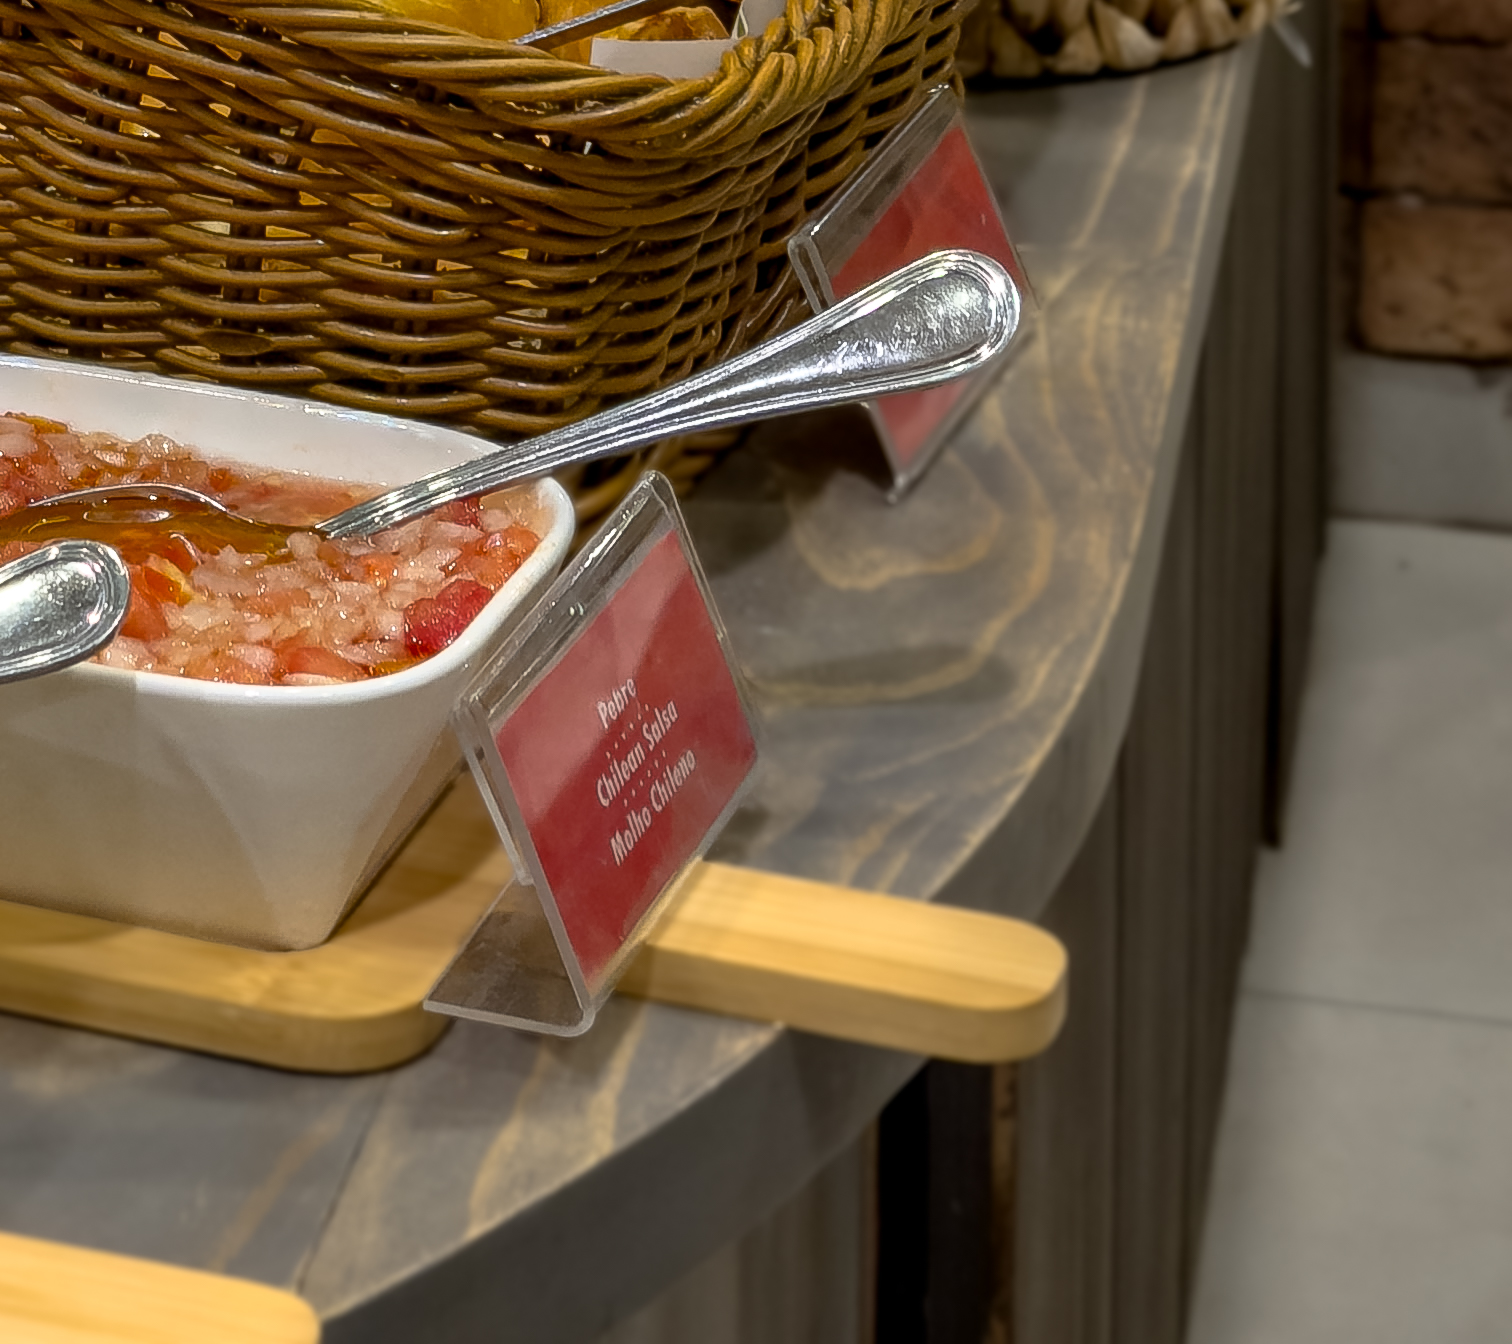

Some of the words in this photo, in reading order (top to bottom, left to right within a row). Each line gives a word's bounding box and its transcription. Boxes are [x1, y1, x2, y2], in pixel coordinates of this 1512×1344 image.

[596, 741, 646, 808] Chilean
[642, 699, 679, 752] Salsa
[597, 677, 637, 729] Pebre
[608, 809, 653, 867] Molho
[649, 748, 698, 814] Chileno
